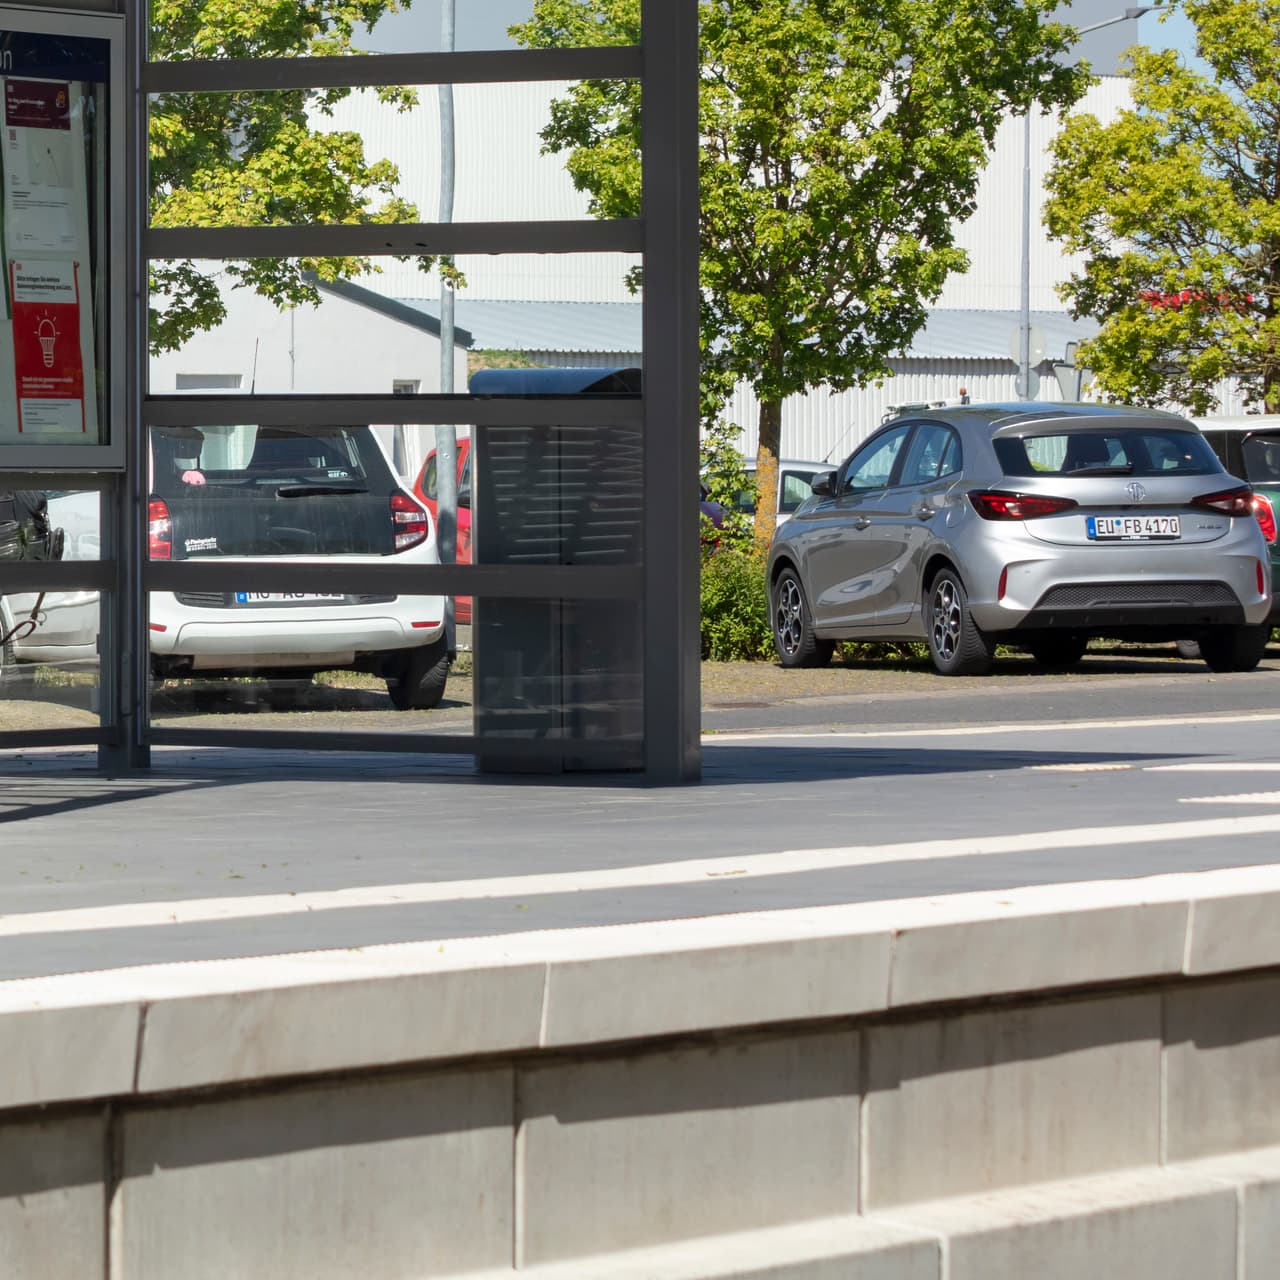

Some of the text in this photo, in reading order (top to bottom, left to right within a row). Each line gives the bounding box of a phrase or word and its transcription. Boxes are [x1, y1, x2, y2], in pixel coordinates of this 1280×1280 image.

[1096, 518, 1178, 534] EU FB 4170
